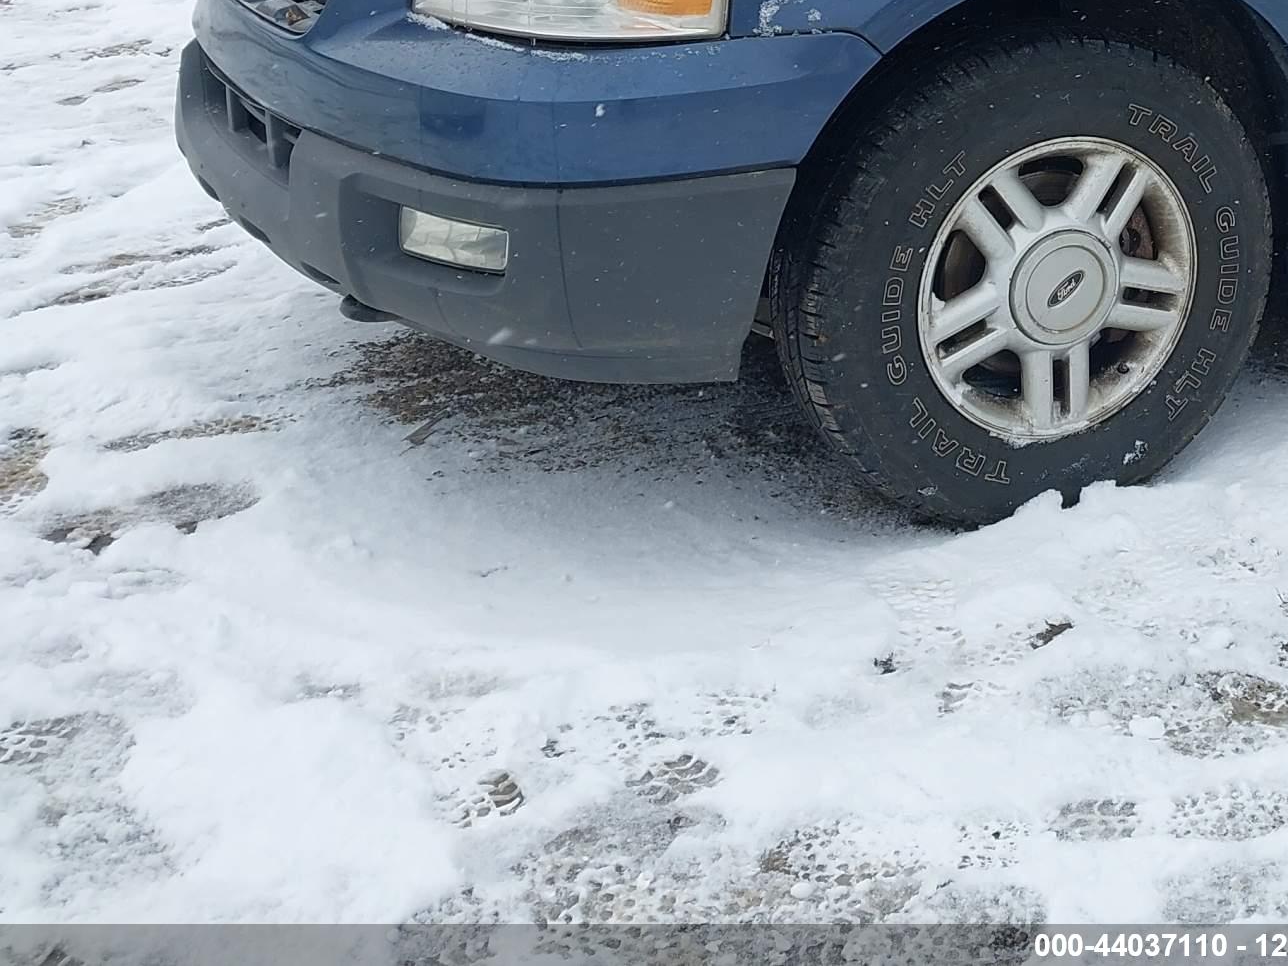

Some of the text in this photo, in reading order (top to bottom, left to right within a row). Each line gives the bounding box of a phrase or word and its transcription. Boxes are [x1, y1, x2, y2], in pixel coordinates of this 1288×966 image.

[881, 151, 1011, 484] TRAIL GUIDE HLT
[1128, 104, 1239, 421] TRAIL GUIDE HLT
